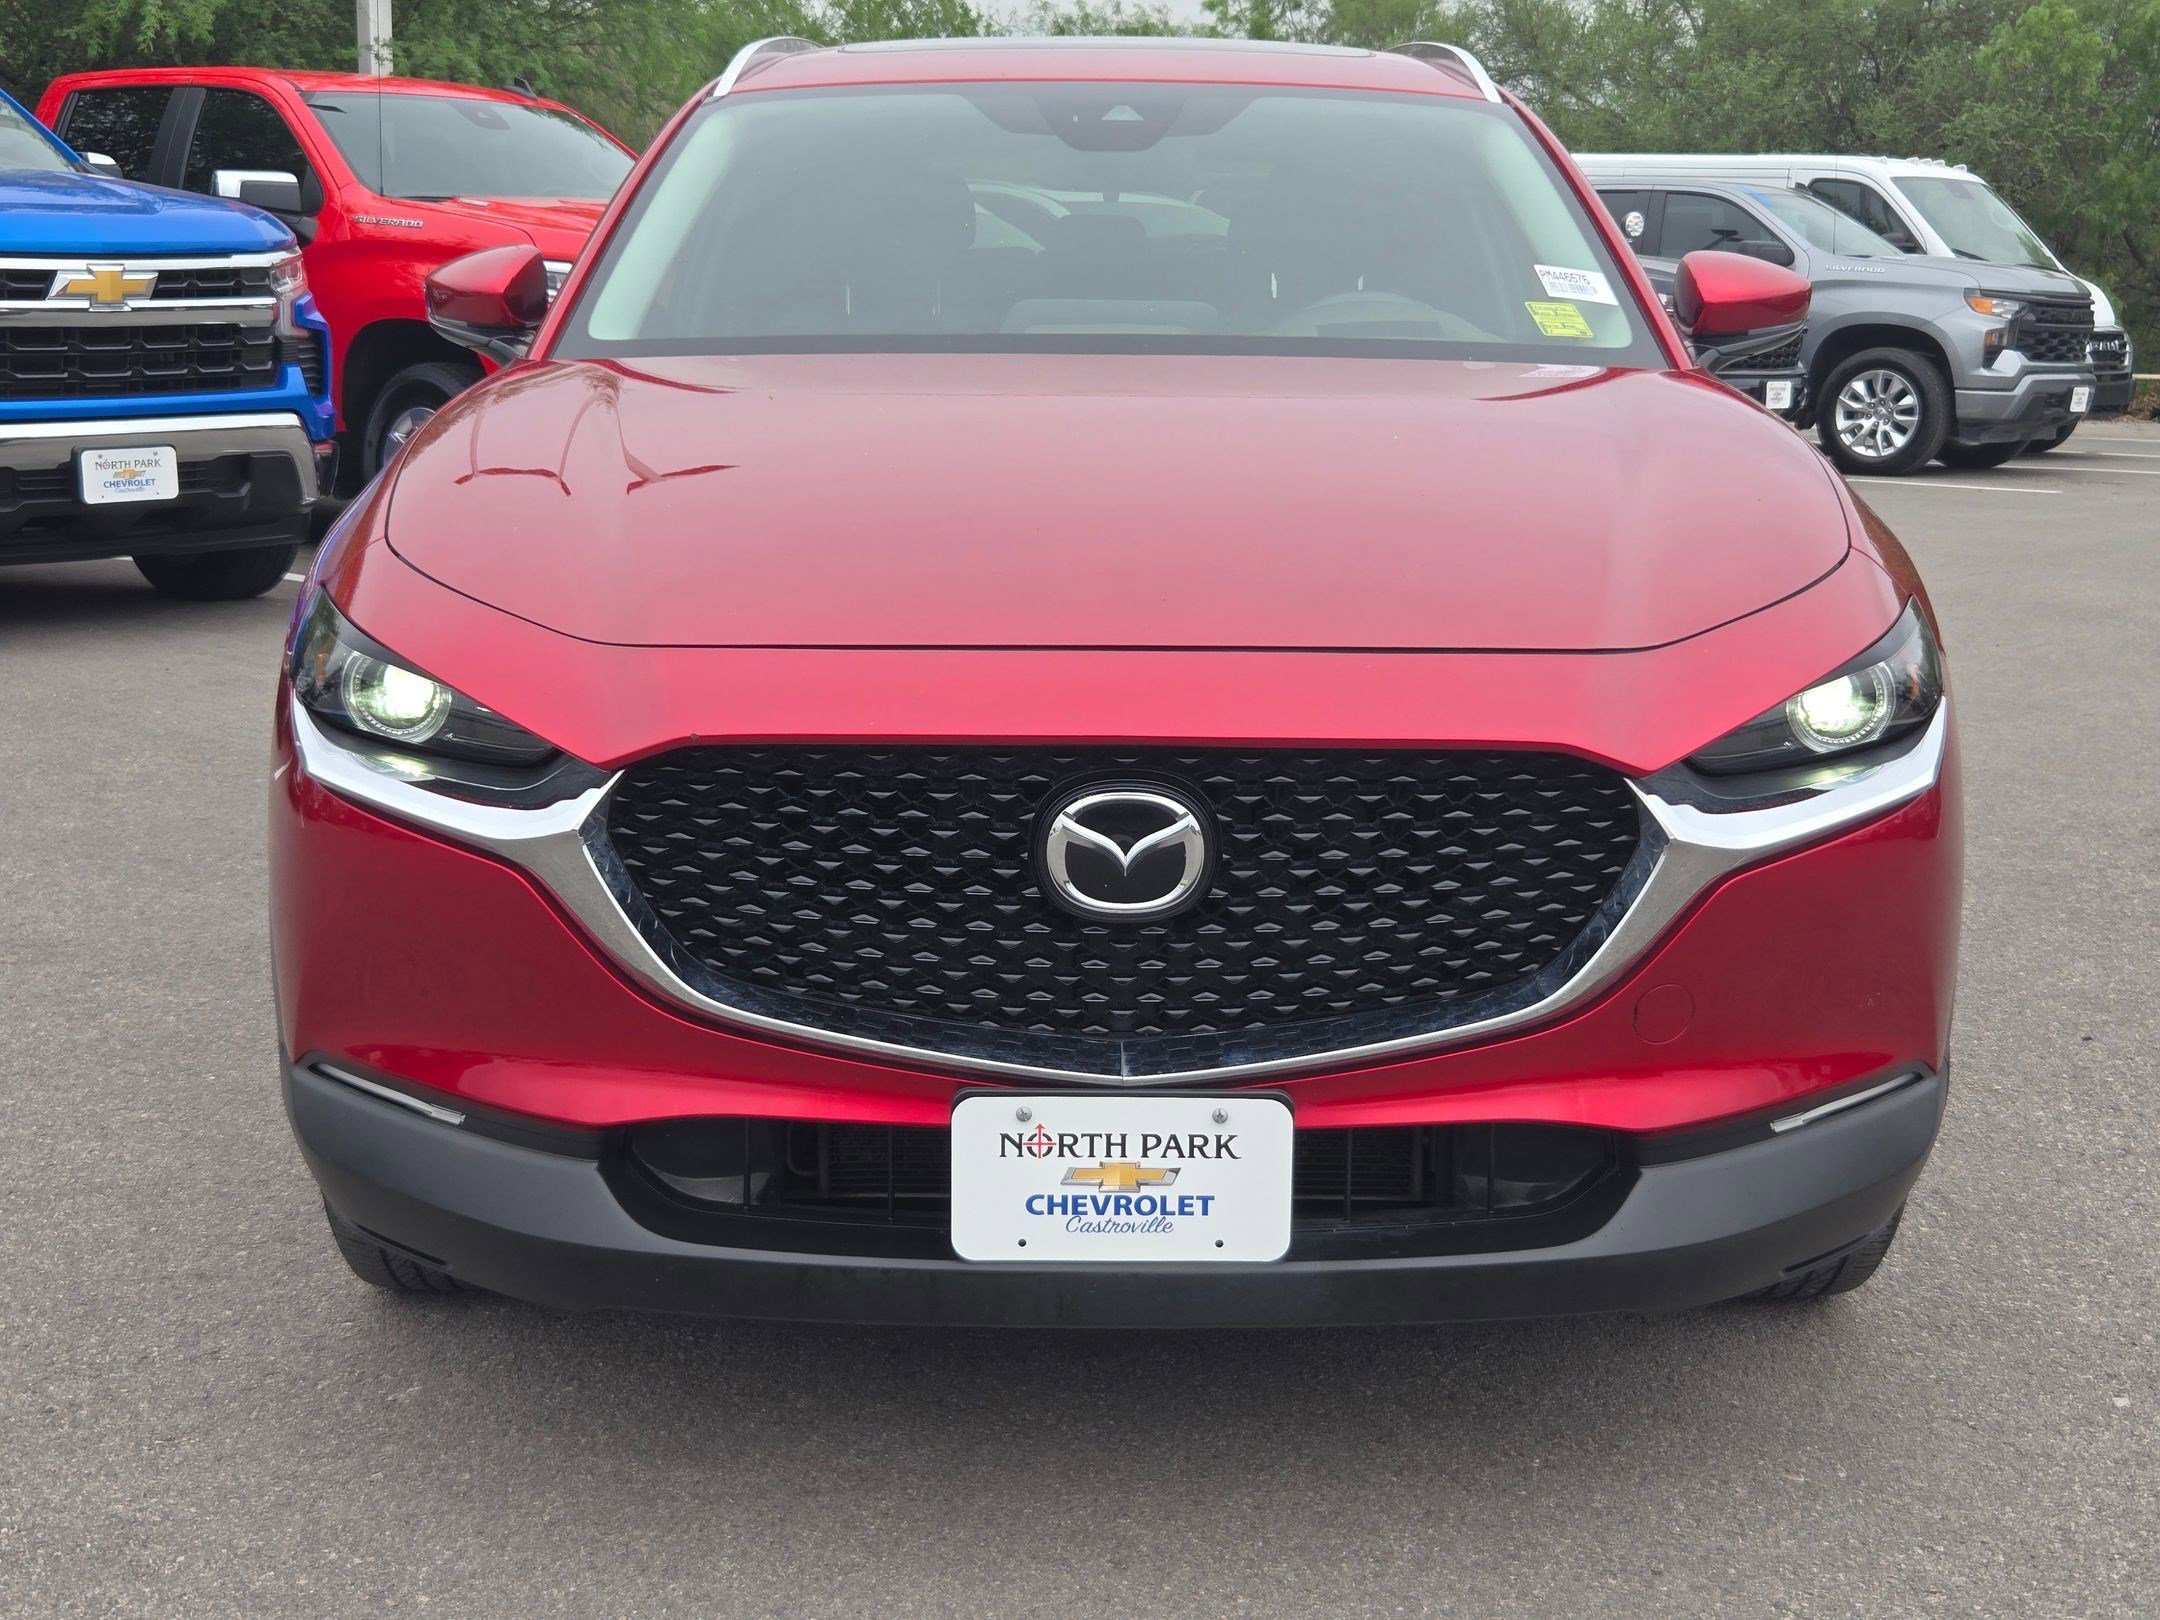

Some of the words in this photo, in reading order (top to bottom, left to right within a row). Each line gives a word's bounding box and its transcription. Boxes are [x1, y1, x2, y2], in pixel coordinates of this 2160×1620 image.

[354, 215, 424, 229] SILVERADO
[95, 459, 131, 471] NORTH
[134, 459, 162, 468] PARK
[103, 478, 155, 488] CHEVROLET
[999, 1131, 1128, 1160] NORTH
[1140, 1134, 1242, 1160] PARK
[1025, 1194, 1215, 1217] CHEVROLET
[1065, 1215, 1175, 1234] Castroville
